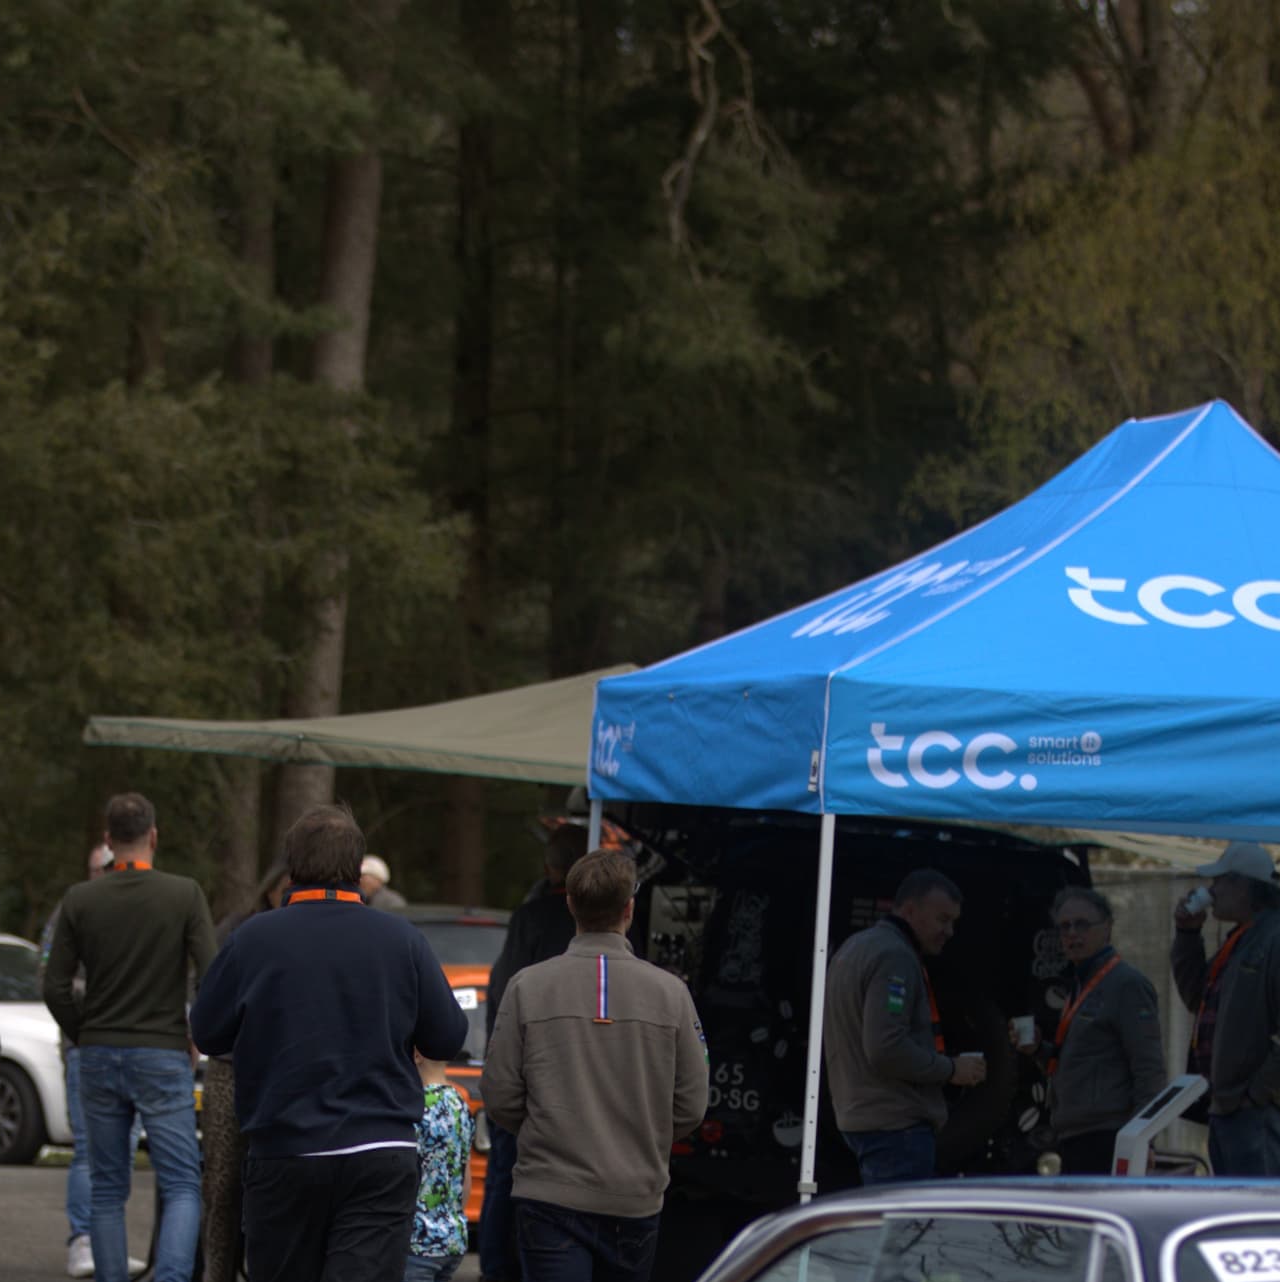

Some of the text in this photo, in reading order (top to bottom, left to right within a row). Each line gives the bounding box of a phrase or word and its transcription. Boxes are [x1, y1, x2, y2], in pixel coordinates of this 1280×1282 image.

[1028, 735, 1079, 749] smart
[1027, 749, 1102, 767] solutions
[714, 1062, 745, 1085] 65
